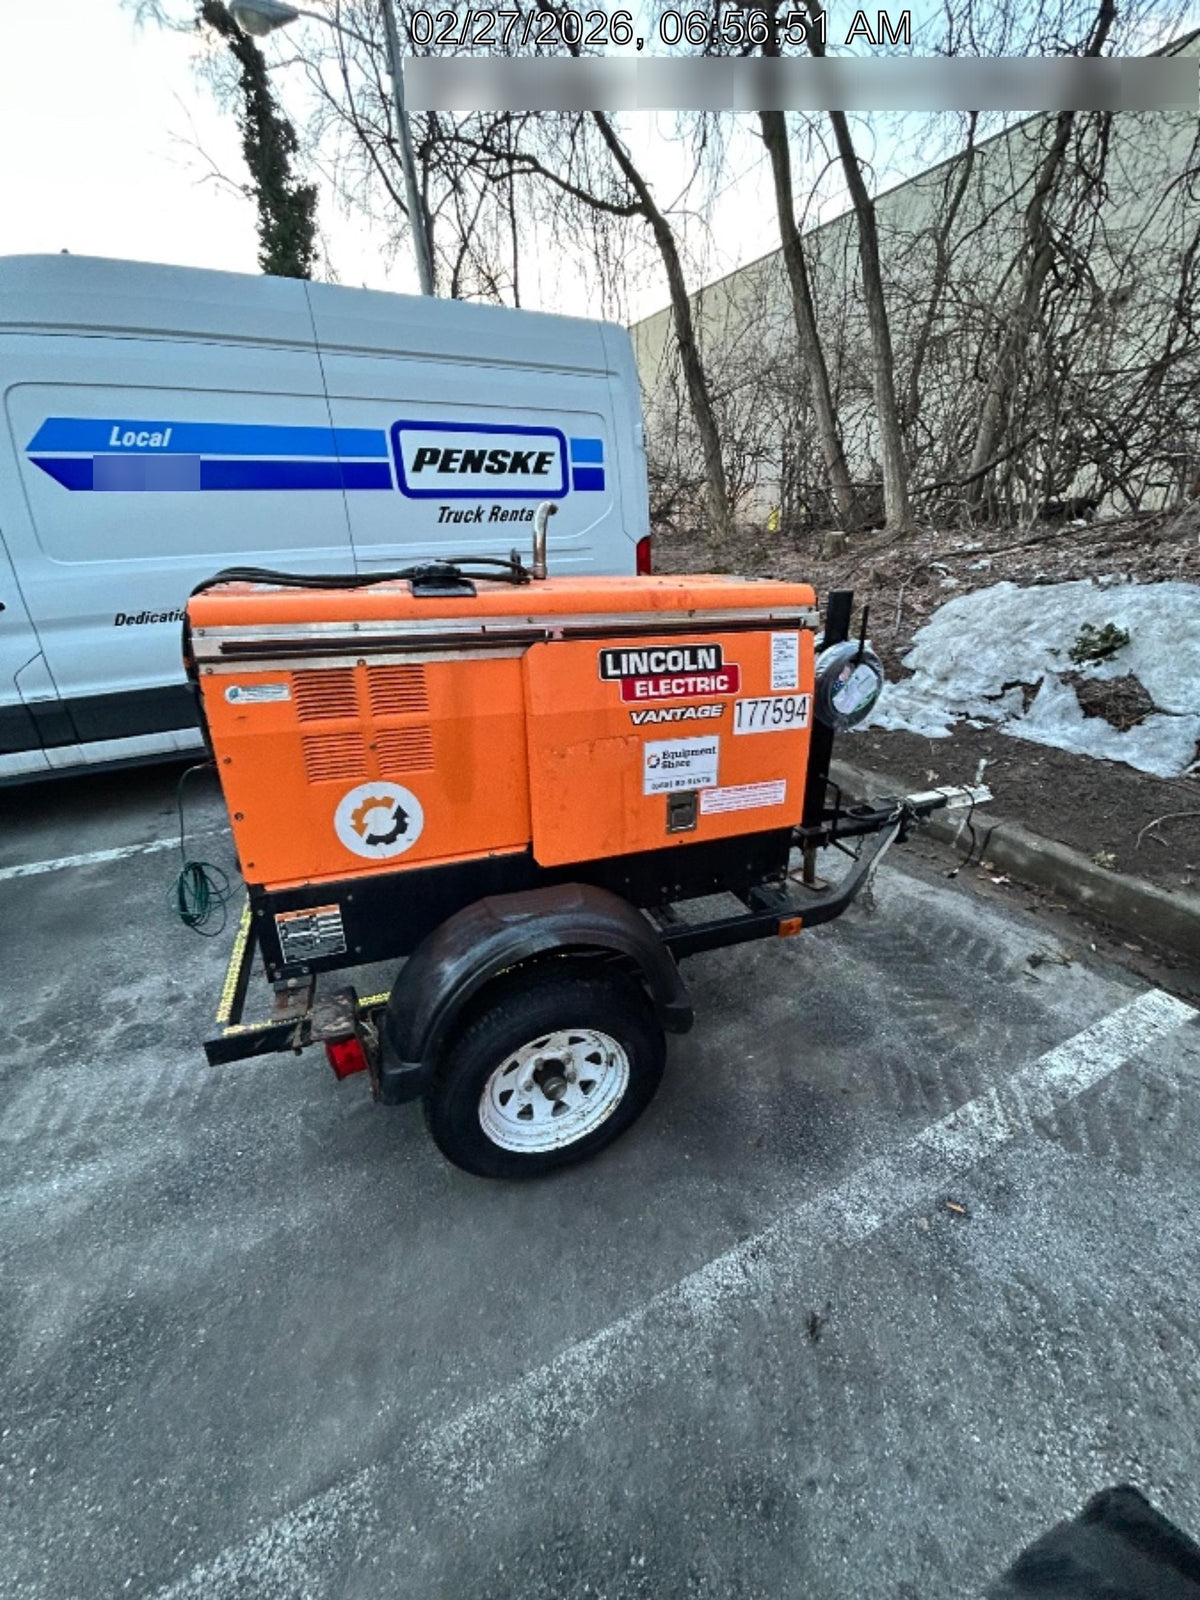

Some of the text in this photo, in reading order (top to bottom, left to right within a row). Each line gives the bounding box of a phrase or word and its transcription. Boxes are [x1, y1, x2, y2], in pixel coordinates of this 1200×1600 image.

[109, 426, 172, 447] Local
[411, 447, 556, 475] PENSKE
[437, 504, 535, 524] Truck Renta
[114, 609, 187, 627] Dedicatio
[606, 648, 716, 676] LINCOLN
[634, 675, 730, 698] ELECTRIC
[630, 704, 725, 725] VANTAGE
[735, 696, 807, 729] 177594
[662, 746, 716, 761] Equipment
[661, 760, 691, 770] Share
